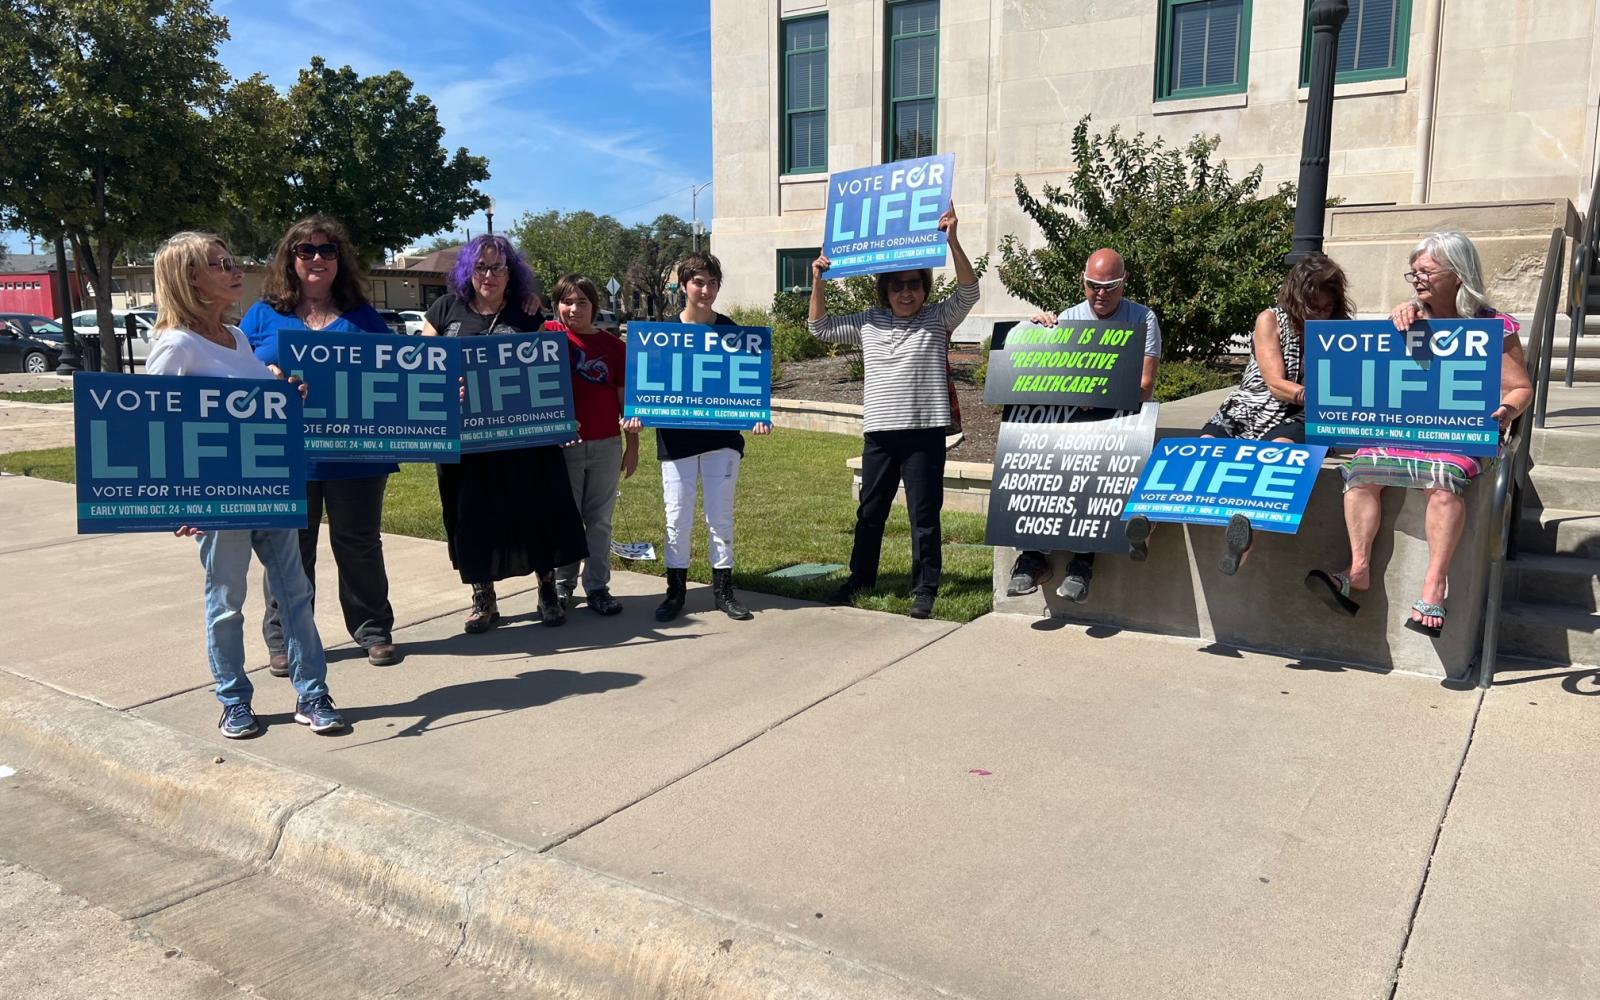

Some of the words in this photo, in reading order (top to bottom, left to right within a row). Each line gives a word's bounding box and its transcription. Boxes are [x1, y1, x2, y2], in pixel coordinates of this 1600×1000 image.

[837, 175, 883, 197] VOTE
[891, 163, 945, 191] FOR
[832, 187, 942, 242] LIFE
[831, 245, 851, 254] VOTE
[851, 242, 869, 251] FOR
[870, 240, 885, 248] THE
[886, 233, 939, 247] ORDINANCE
[638, 332, 694, 348] VOTE
[704, 331, 763, 353] FOR
[1078, 328, 1096, 345] IS
[1099, 329, 1134, 347] NOT
[1318, 334, 1391, 352] VOTE
[1405, 330, 1489, 357] FOR
[290, 344, 362, 364] VOTE
[375, 343, 448, 372] FOR
[462, 347, 488, 365] TE
[498, 339, 560, 366] FOR
[636, 351, 762, 394] LIFE
[464, 364, 565, 415] IFE
[1318, 359, 1486, 411] LIFE
[89, 388, 182, 412] VOTE
[199, 388, 288, 420] FOR
[636, 395, 661, 404] VOTE
[663, 395, 683, 404] FOR
[685, 396, 703, 405] THE
[705, 397, 762, 407] ORDINANCE
[464, 418, 485, 428] FOR
[486, 415, 505, 425] THE
[507, 410, 566, 423] ORDINANCE
[1318, 411, 1348, 421] VOTE
[1351, 412, 1376, 422] FOR
[1379, 413, 1402, 423] THE
[1405, 415, 1484, 426] ORDINANCE
[303, 424, 322, 434] OTE
[325, 424, 350, 435] FOR
[353, 425, 375, 435] THE
[377, 425, 447, 436] ORDINANCE
[1317, 426, 1336, 434] EARLY
[1337, 427, 1360, 435] VOTING
[1360, 427, 1374, 436] OCT.
[1375, 428, 1384, 436] 24
[1389, 429, 1405, 438] NOV.
[1405, 430, 1411, 438] 4
[1418, 431, 1450, 440] ELECTION
[1450, 432, 1465, 441] DAY
[1466, 433, 1483, 441] NOV.
[1484, 433, 1490, 442] 8
[90, 420, 290, 479] LIFE
[311, 440, 334, 449] VOTING
[334, 440, 348, 449] OCT.
[349, 440, 358, 449] 24
[363, 441, 377, 449] NOV.
[389, 441, 419, 450] ELECTION
[419, 442, 432, 450] DAY
[432, 442, 447, 450] NOV.
[1019, 433, 1049, 450] PRO
[1053, 434, 1128, 452] ABORTION
[1001, 453, 1054, 471] PEOPLE
[1060, 455, 1101, 472] WERE
[1107, 456, 1141, 473] NOT
[1164, 445, 1227, 458] VOTE
[1235, 445, 1310, 466] FOR
[998, 473, 1063, 492] ABORTED
[1069, 475, 1089, 493] BY
[1096, 476, 1139, 495] THEIR
[1144, 460, 1303, 500] LIFE
[92, 486, 133, 497] VOTE
[137, 485, 169, 497] FOR
[173, 486, 201, 496] THE
[204, 485, 290, 496] ORDINANCE
[91, 505, 117, 516] EARLY
[118, 505, 148, 515] VOTING
[150, 505, 167, 515] OCT.
[169, 505, 180, 514] 24
[186, 504, 205, 514] NOV.
[206, 504, 212, 513] 4
[220, 504, 256, 513] ELECTION
[257, 504, 272, 513] DAY
[273, 503, 291, 513] NOV.
[291, 503, 297, 512] 8
[1008, 494, 1078, 516] MOTHERS,
[1087, 498, 1123, 517] WHO
[1169, 494, 1193, 502] FOR
[1195, 496, 1216, 504] THE
[1219, 498, 1290, 511] ORDINANCE
[1015, 516, 1062, 536] CHOSE
